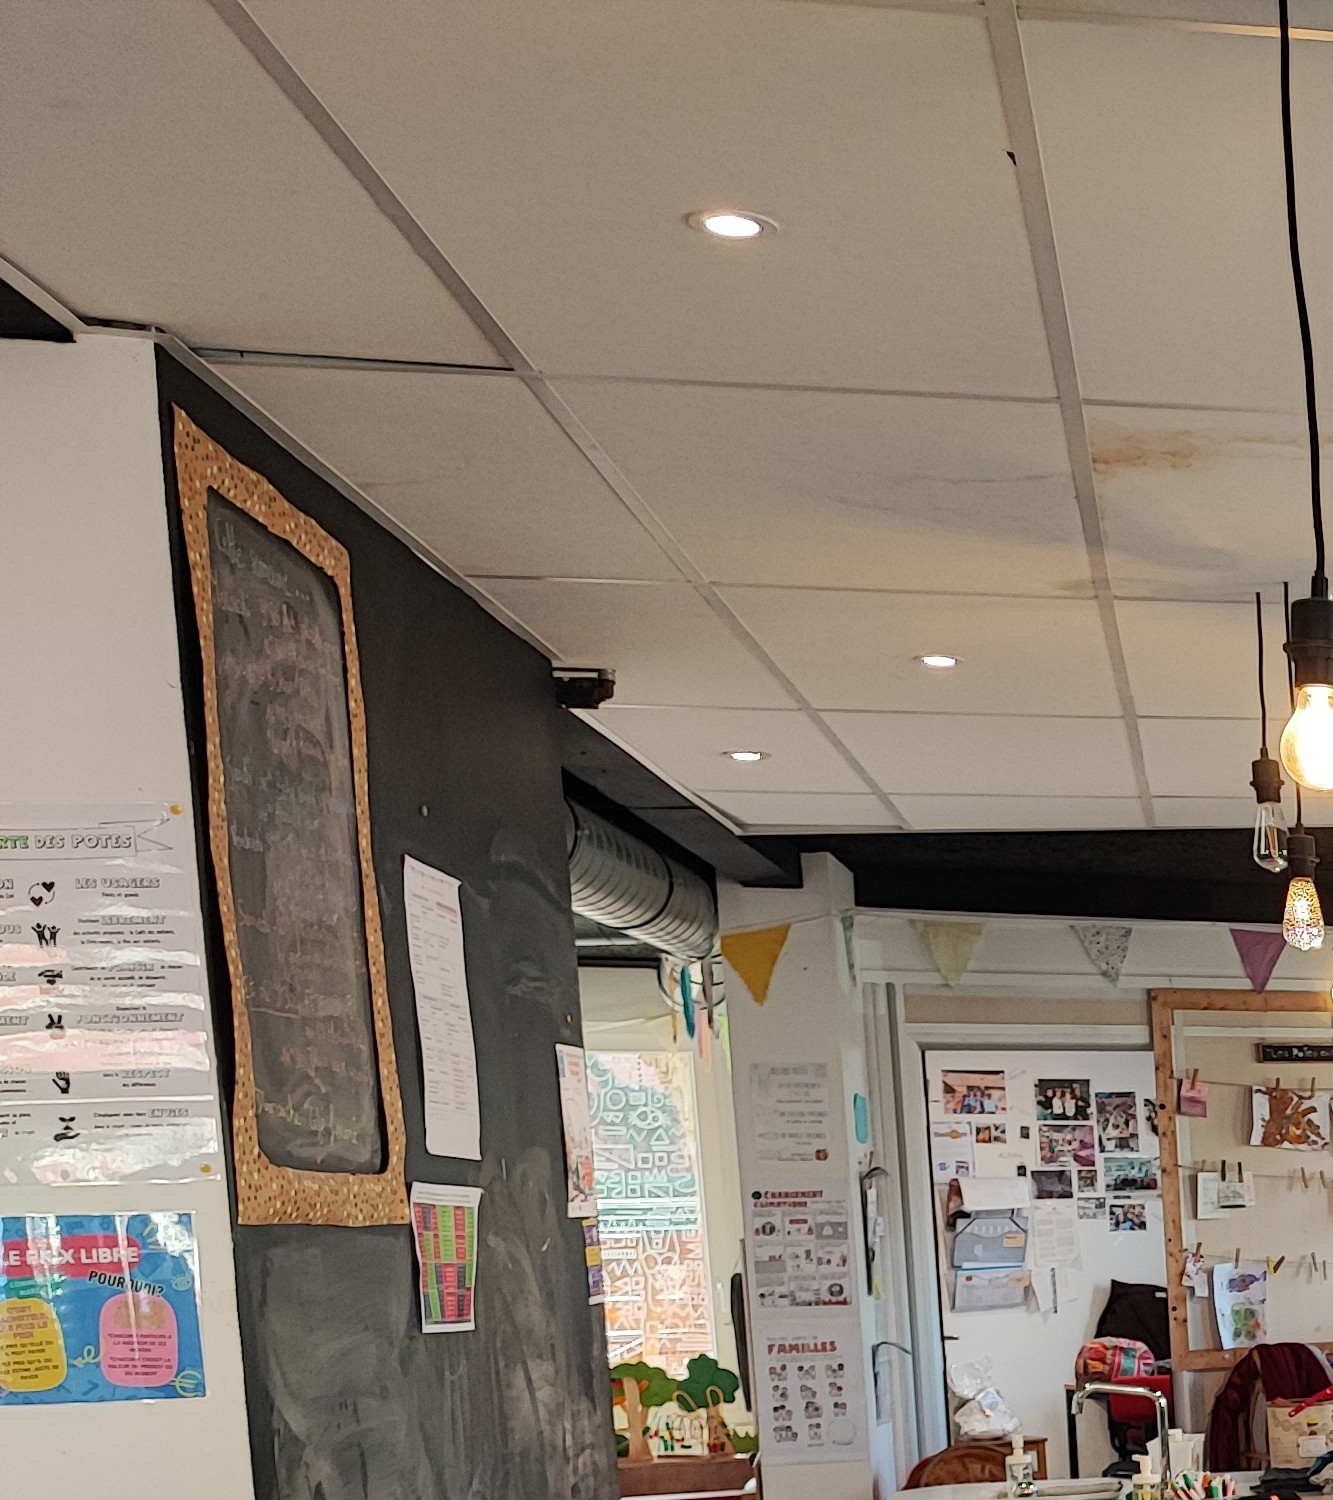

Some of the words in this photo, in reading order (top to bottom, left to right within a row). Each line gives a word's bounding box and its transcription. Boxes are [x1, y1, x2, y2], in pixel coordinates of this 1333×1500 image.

[35, 835, 65, 848] DES
[71, 834, 132, 848] POTES
[26, 1249, 76, 1265] PRX
[767, 1341, 837, 1354] FAMILLES
